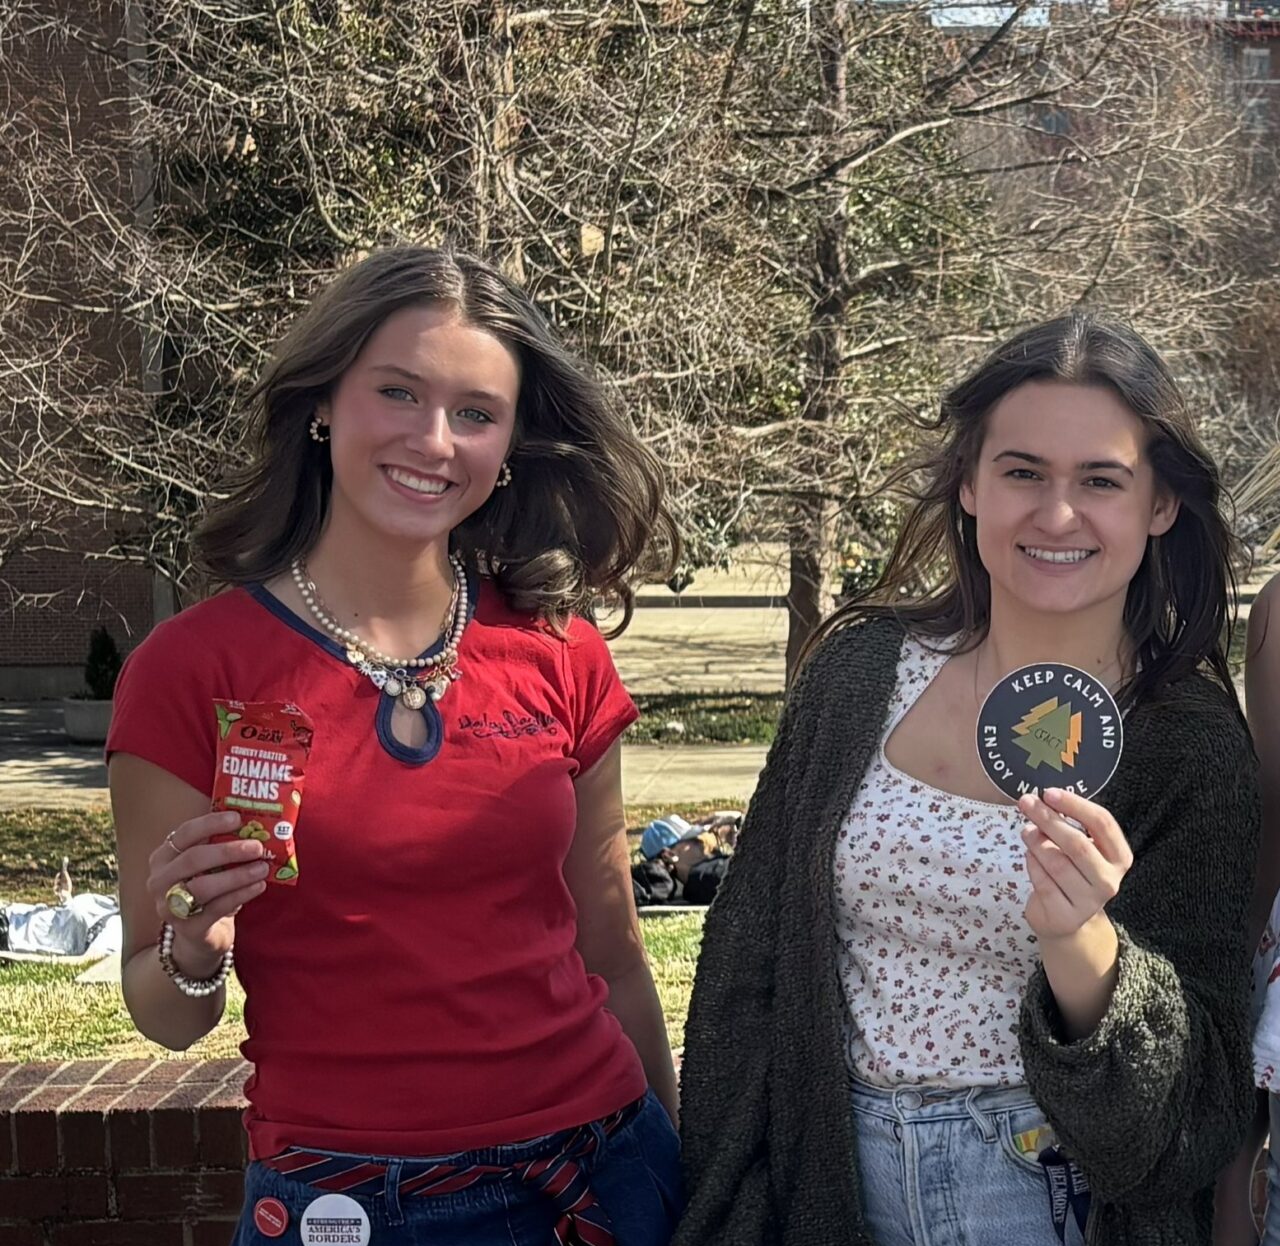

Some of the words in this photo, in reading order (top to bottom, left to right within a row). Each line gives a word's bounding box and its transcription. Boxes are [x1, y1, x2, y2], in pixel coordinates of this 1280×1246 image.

[1011, 671, 1054, 693] KEEP
[1063, 674, 1104, 708] CALM
[1100, 715, 1115, 749] AND
[1034, 728, 1062, 749] CFACT
[984, 725, 1013, 780] ENJOY
[222, 755, 293, 782] EDAMAME
[231, 776, 279, 801] BEANS
[308, 1234, 361, 1243] BORDERS
